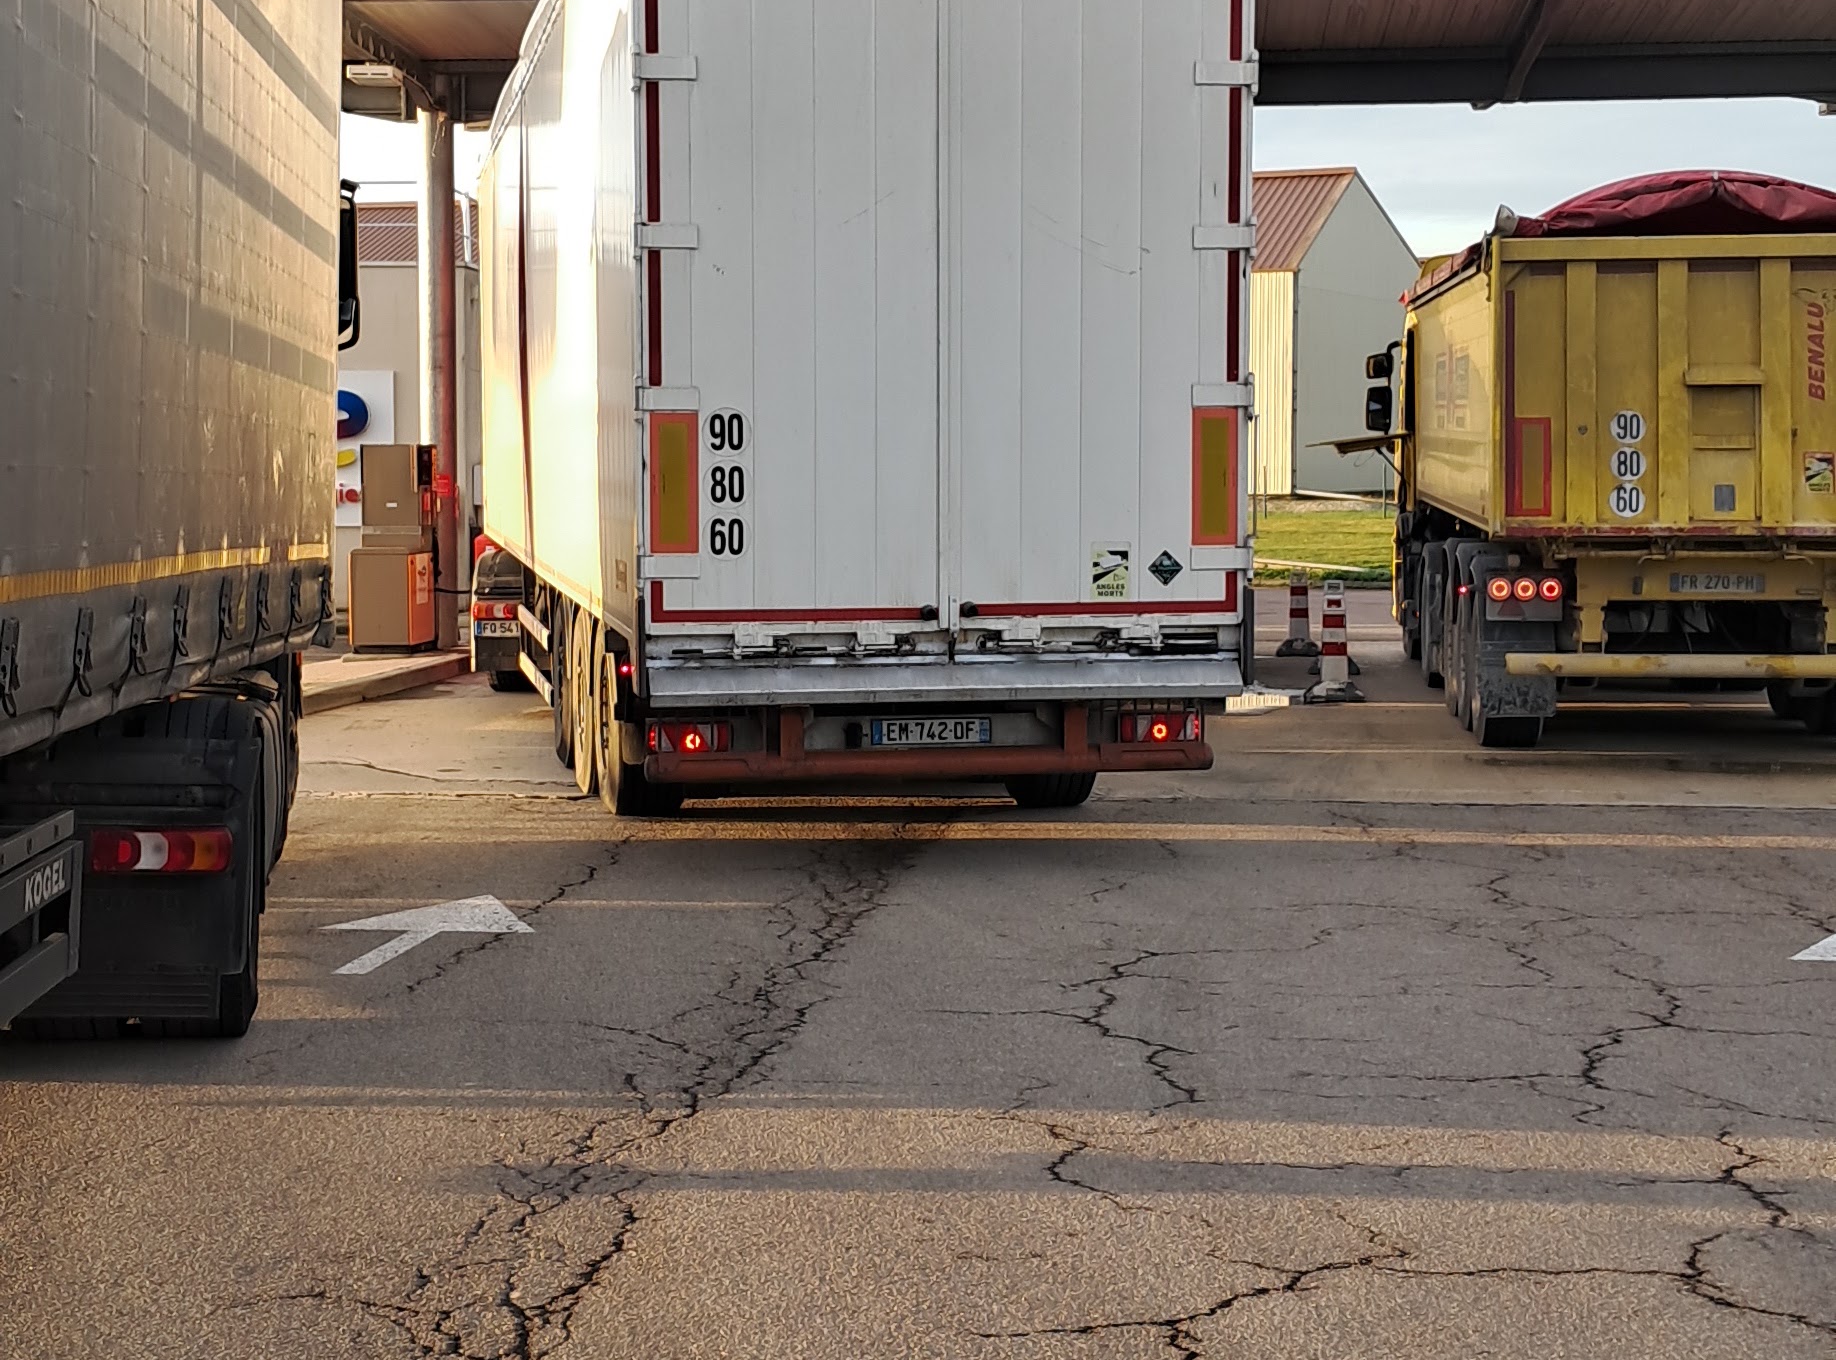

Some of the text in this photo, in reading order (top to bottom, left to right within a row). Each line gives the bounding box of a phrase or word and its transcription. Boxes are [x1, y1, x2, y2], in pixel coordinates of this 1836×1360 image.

[1807, 301, 1826, 401] BENALU
[709, 413, 744, 451] 90
[1616, 413, 1641, 440] 90
[1617, 450, 1641, 477] 80
[710, 465, 745, 503] 80
[1616, 486, 1640, 513] 60
[709, 517, 744, 555] 60
